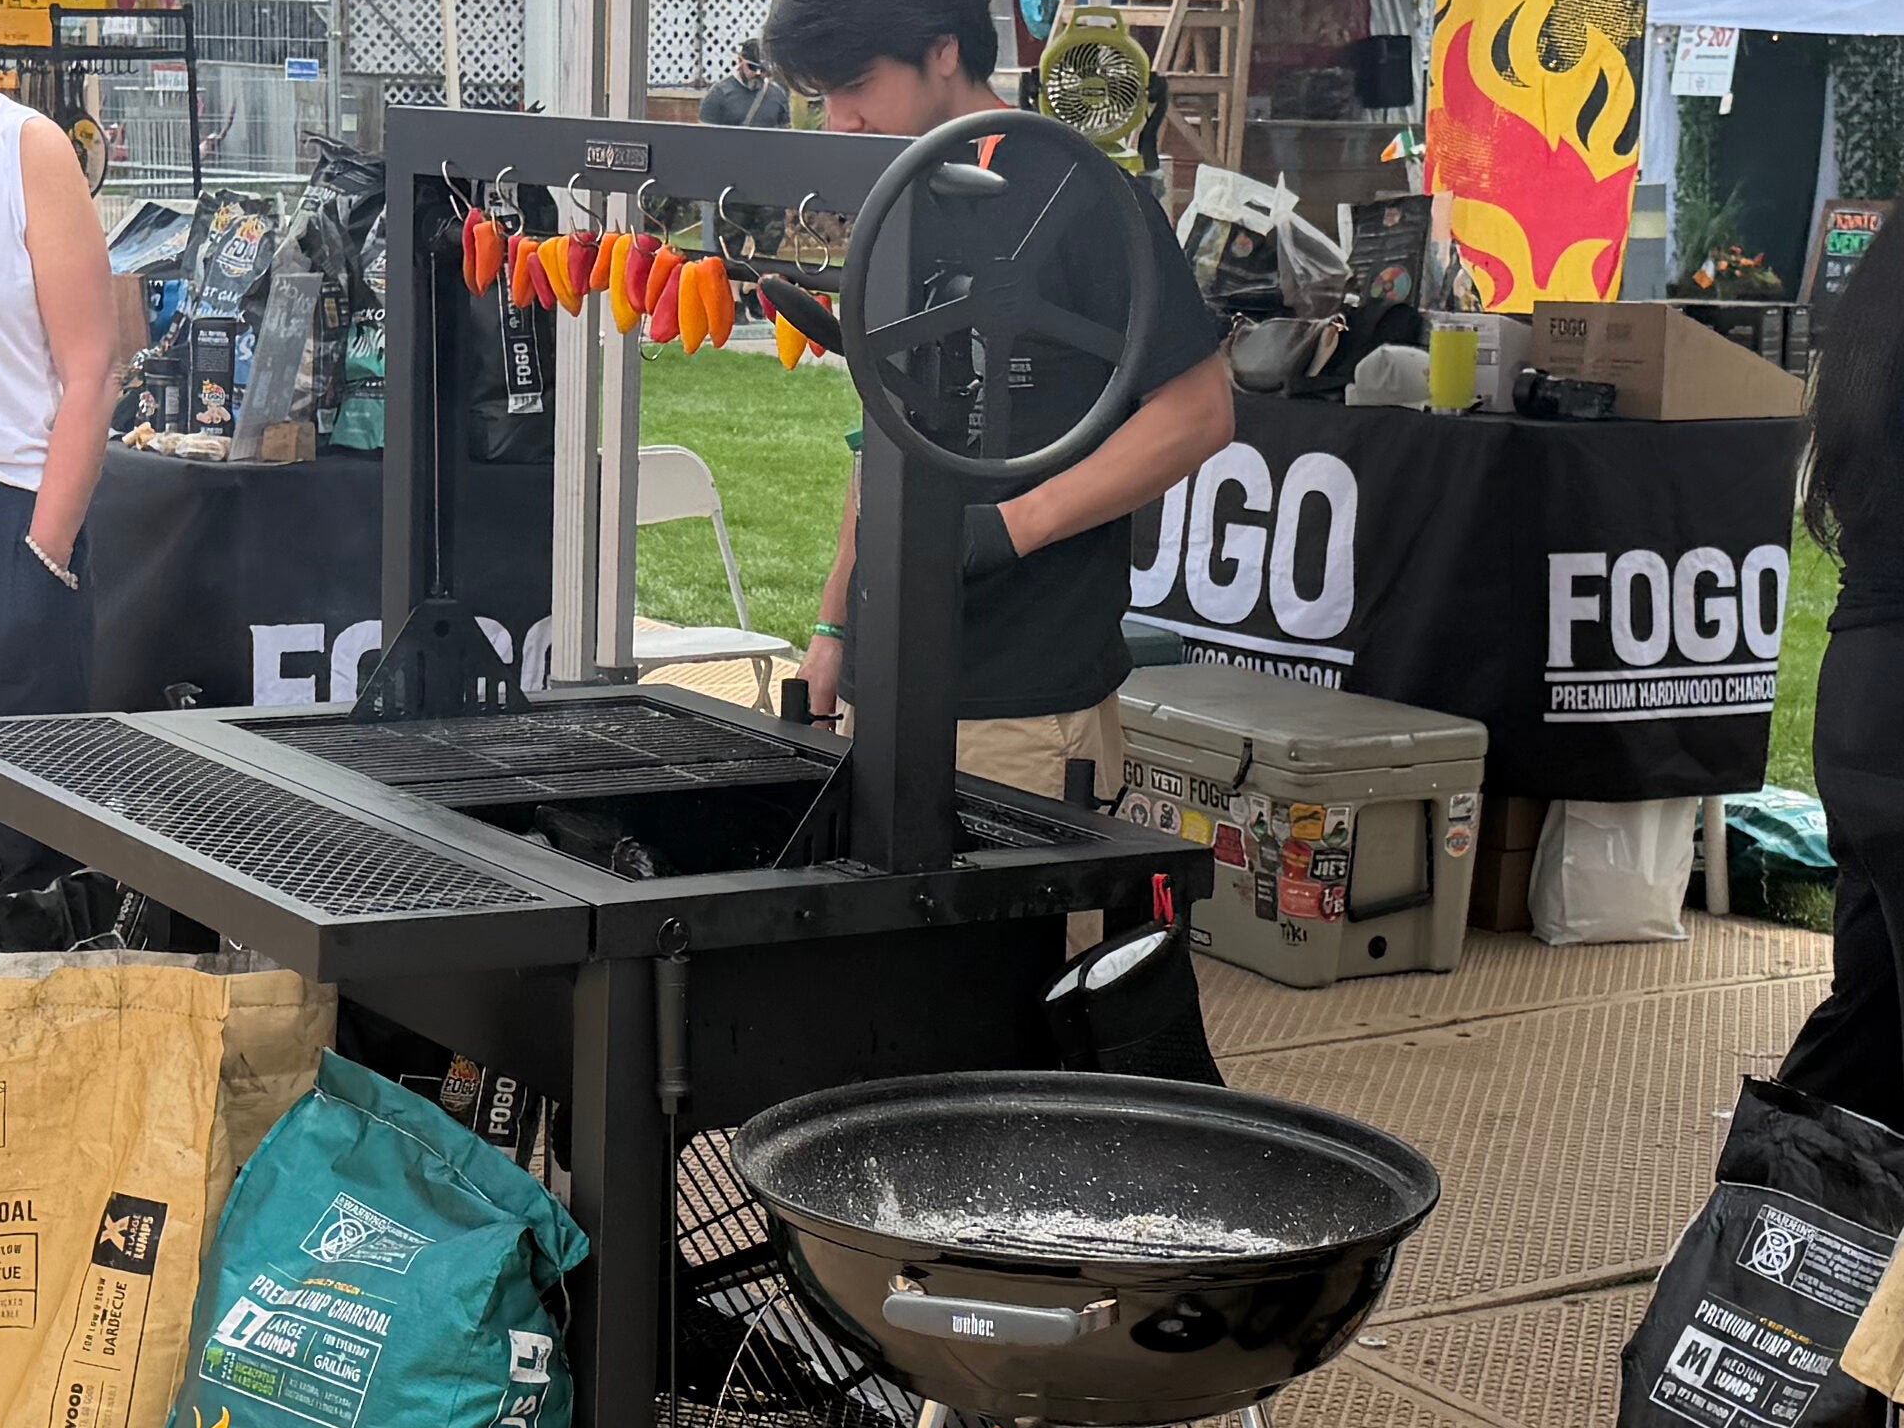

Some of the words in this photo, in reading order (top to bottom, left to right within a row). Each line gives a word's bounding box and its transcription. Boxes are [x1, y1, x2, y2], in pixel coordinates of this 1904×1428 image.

[516, 342, 533, 387] FOGO
[1548, 543, 1791, 668] FOGO
[1550, 680, 1636, 712] PREMIUM
[1639, 679, 1723, 711] HARDWOOD
[1152, 769, 1181, 796] YETI
[1313, 860, 1347, 876] JOE'S
[488, 1075, 517, 1136] FOGO
[135, 1215, 155, 1261] LUMPS
[83, 1333, 94, 1353] FOR
[89, 1314, 100, 1333] LOW
[97, 1276, 107, 1302] SLOW
[102, 1280, 128, 1357] BARBECUE
[266, 1313, 308, 1341] LARGE
[295, 1288, 331, 1314] LUMP
[328, 1292, 393, 1337] CHARCOAL
[1694, 1299, 1756, 1343] PREMIUM
[1751, 1328, 1791, 1358] LUMP
[255, 1331, 298, 1360] LUMPS
[322, 1333, 336, 1347] FOR
[314, 1353, 362, 1383] GRILLING
[1721, 1356, 1766, 1386] MEDIUM
[1713, 1369, 1759, 1403] LUMPS
